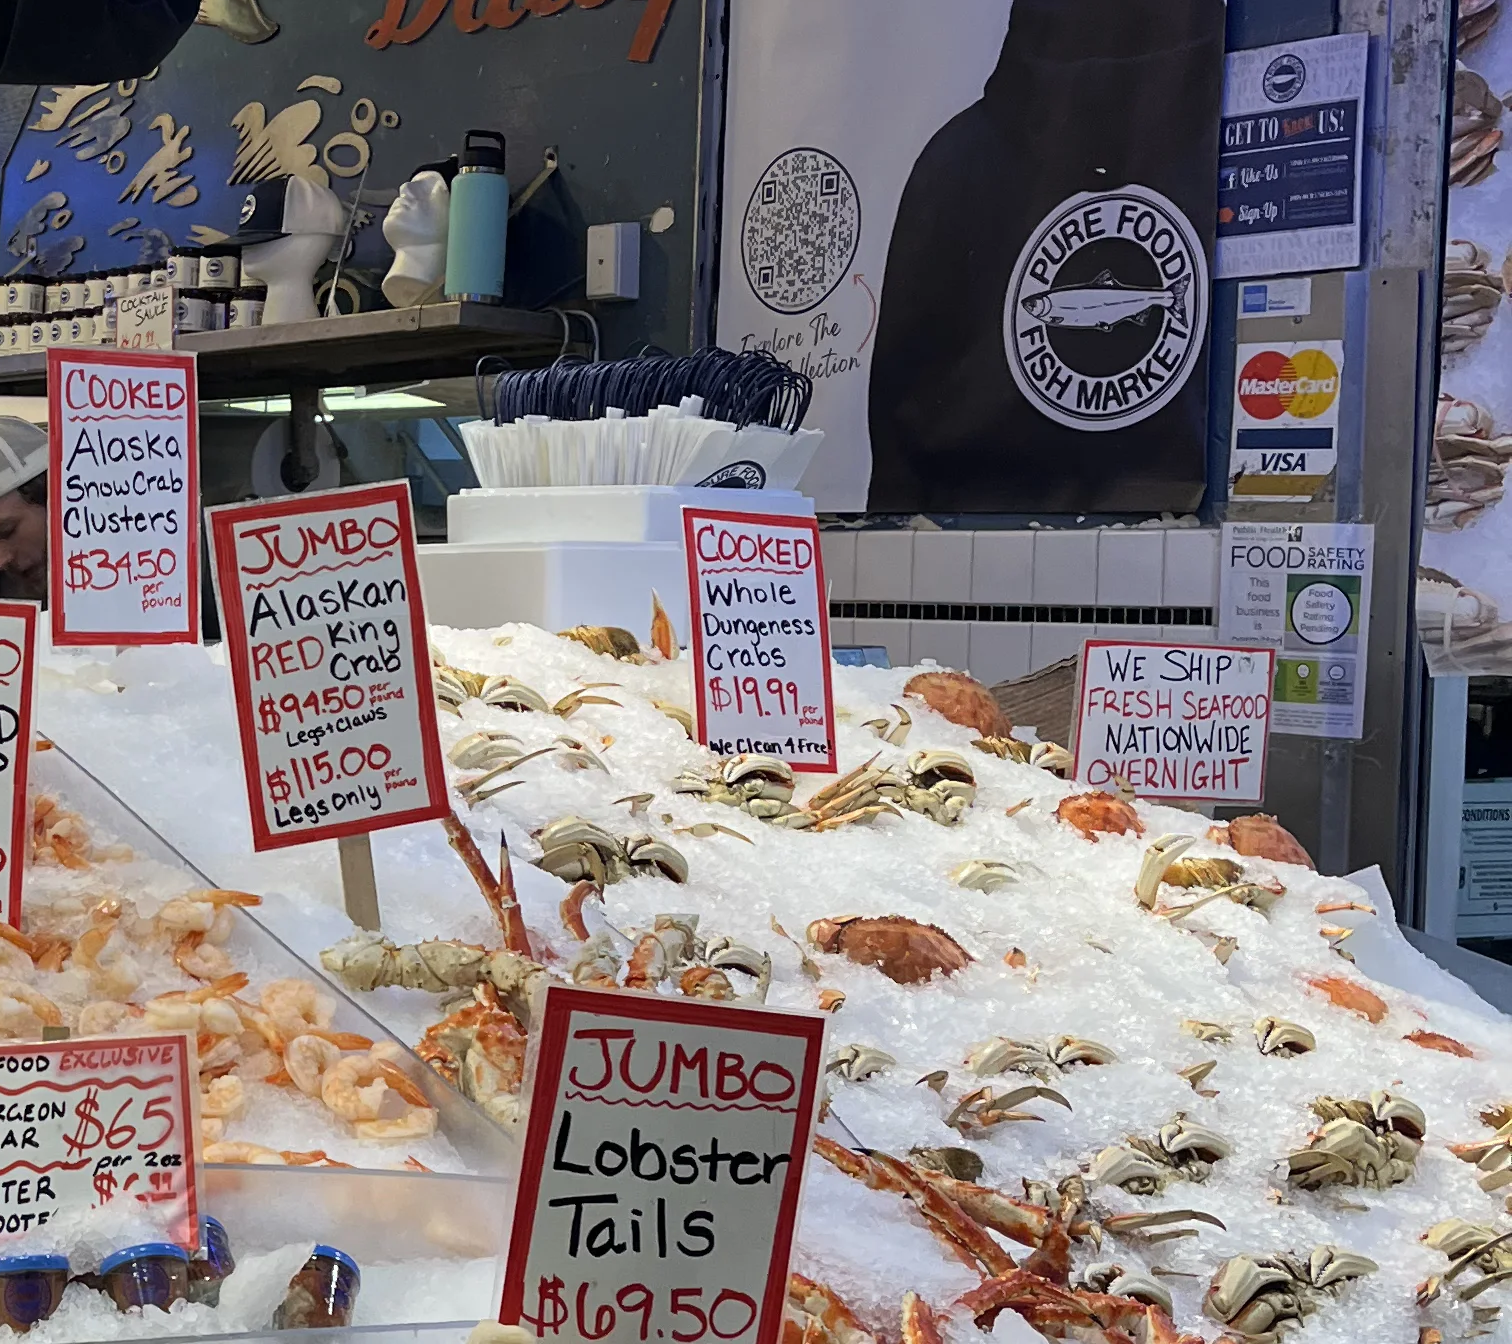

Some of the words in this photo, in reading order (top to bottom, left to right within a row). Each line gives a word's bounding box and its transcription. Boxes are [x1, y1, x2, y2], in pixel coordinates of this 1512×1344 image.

[1225, 120, 1255, 146] GET
[1258, 117, 1278, 142] TO
[1029, 207, 1106, 285] PURE
[1117, 205, 1186, 280] FOOD
[121, 292, 168, 312] COCKTAIL
[809, 313, 841, 346] The
[1019, 324, 1073, 400] FISH
[1076, 318, 1187, 411] MARKET
[65, 368, 186, 411] COOKED
[1240, 376, 1336, 396] MasterCard
[66, 428, 181, 471] Alaska
[1260, 453, 1306, 472] VISA
[66, 474, 130, 502] Snow
[132, 468, 183, 496] Crab
[63, 505, 178, 538] Clusters
[240, 516, 399, 574] JUMBO
[696, 524, 812, 569] COOKED
[1231, 545, 1305, 569] FOOD
[1308, 547, 1365, 558] SAFETY
[65, 548, 176, 593] $34.50
[1307, 559, 1364, 571] RATING
[143, 582, 164, 597] per
[706, 578, 796, 606] Whole
[1247, 591, 1271, 602] food
[1250, 577, 1270, 588] This
[1308, 589, 1333, 598] Food
[142, 593, 181, 612] pound
[249, 577, 406, 637] Alaskan
[1236, 607, 1280, 617] business
[1305, 600, 1335, 611] Safety
[326, 619, 399, 654] King
[702, 612, 815, 645] Dungeness
[251, 635, 324, 681] RED
[330, 646, 401, 681] Crab
[707, 643, 786, 670] Crabs
[1106, 649, 1146, 682] WE
[1160, 649, 1231, 685] SHIP
[258, 684, 365, 735] $94.50
[369, 681, 391, 697] per
[369, 687, 405, 706] pound
[709, 676, 799, 717] $19.99
[802, 706, 818, 717] per
[1088, 687, 1172, 719] FRESH
[1182, 690, 1269, 720] SEAFOOD
[799, 716, 824, 727] pound
[1106, 720, 1252, 754] NATIONWIDE
[709, 738, 732, 755] We
[736, 738, 783, 755] Clean
[785, 737, 795, 753] 4
[798, 738, 832, 755] Free!
[265, 743, 391, 804] $115.00
[1088, 757, 1249, 791] OVERNIGHT
[274, 797, 331, 828] Legs
[58, 1046, 173, 1072] EXCLUSIVE
[569, 1028, 796, 1102] JUMBO
[62, 1087, 175, 1157] $65
[553, 1110, 792, 1184] Lobster
[549, 1193, 715, 1258] Tails
[520, 1274, 758, 1342] $69.50
